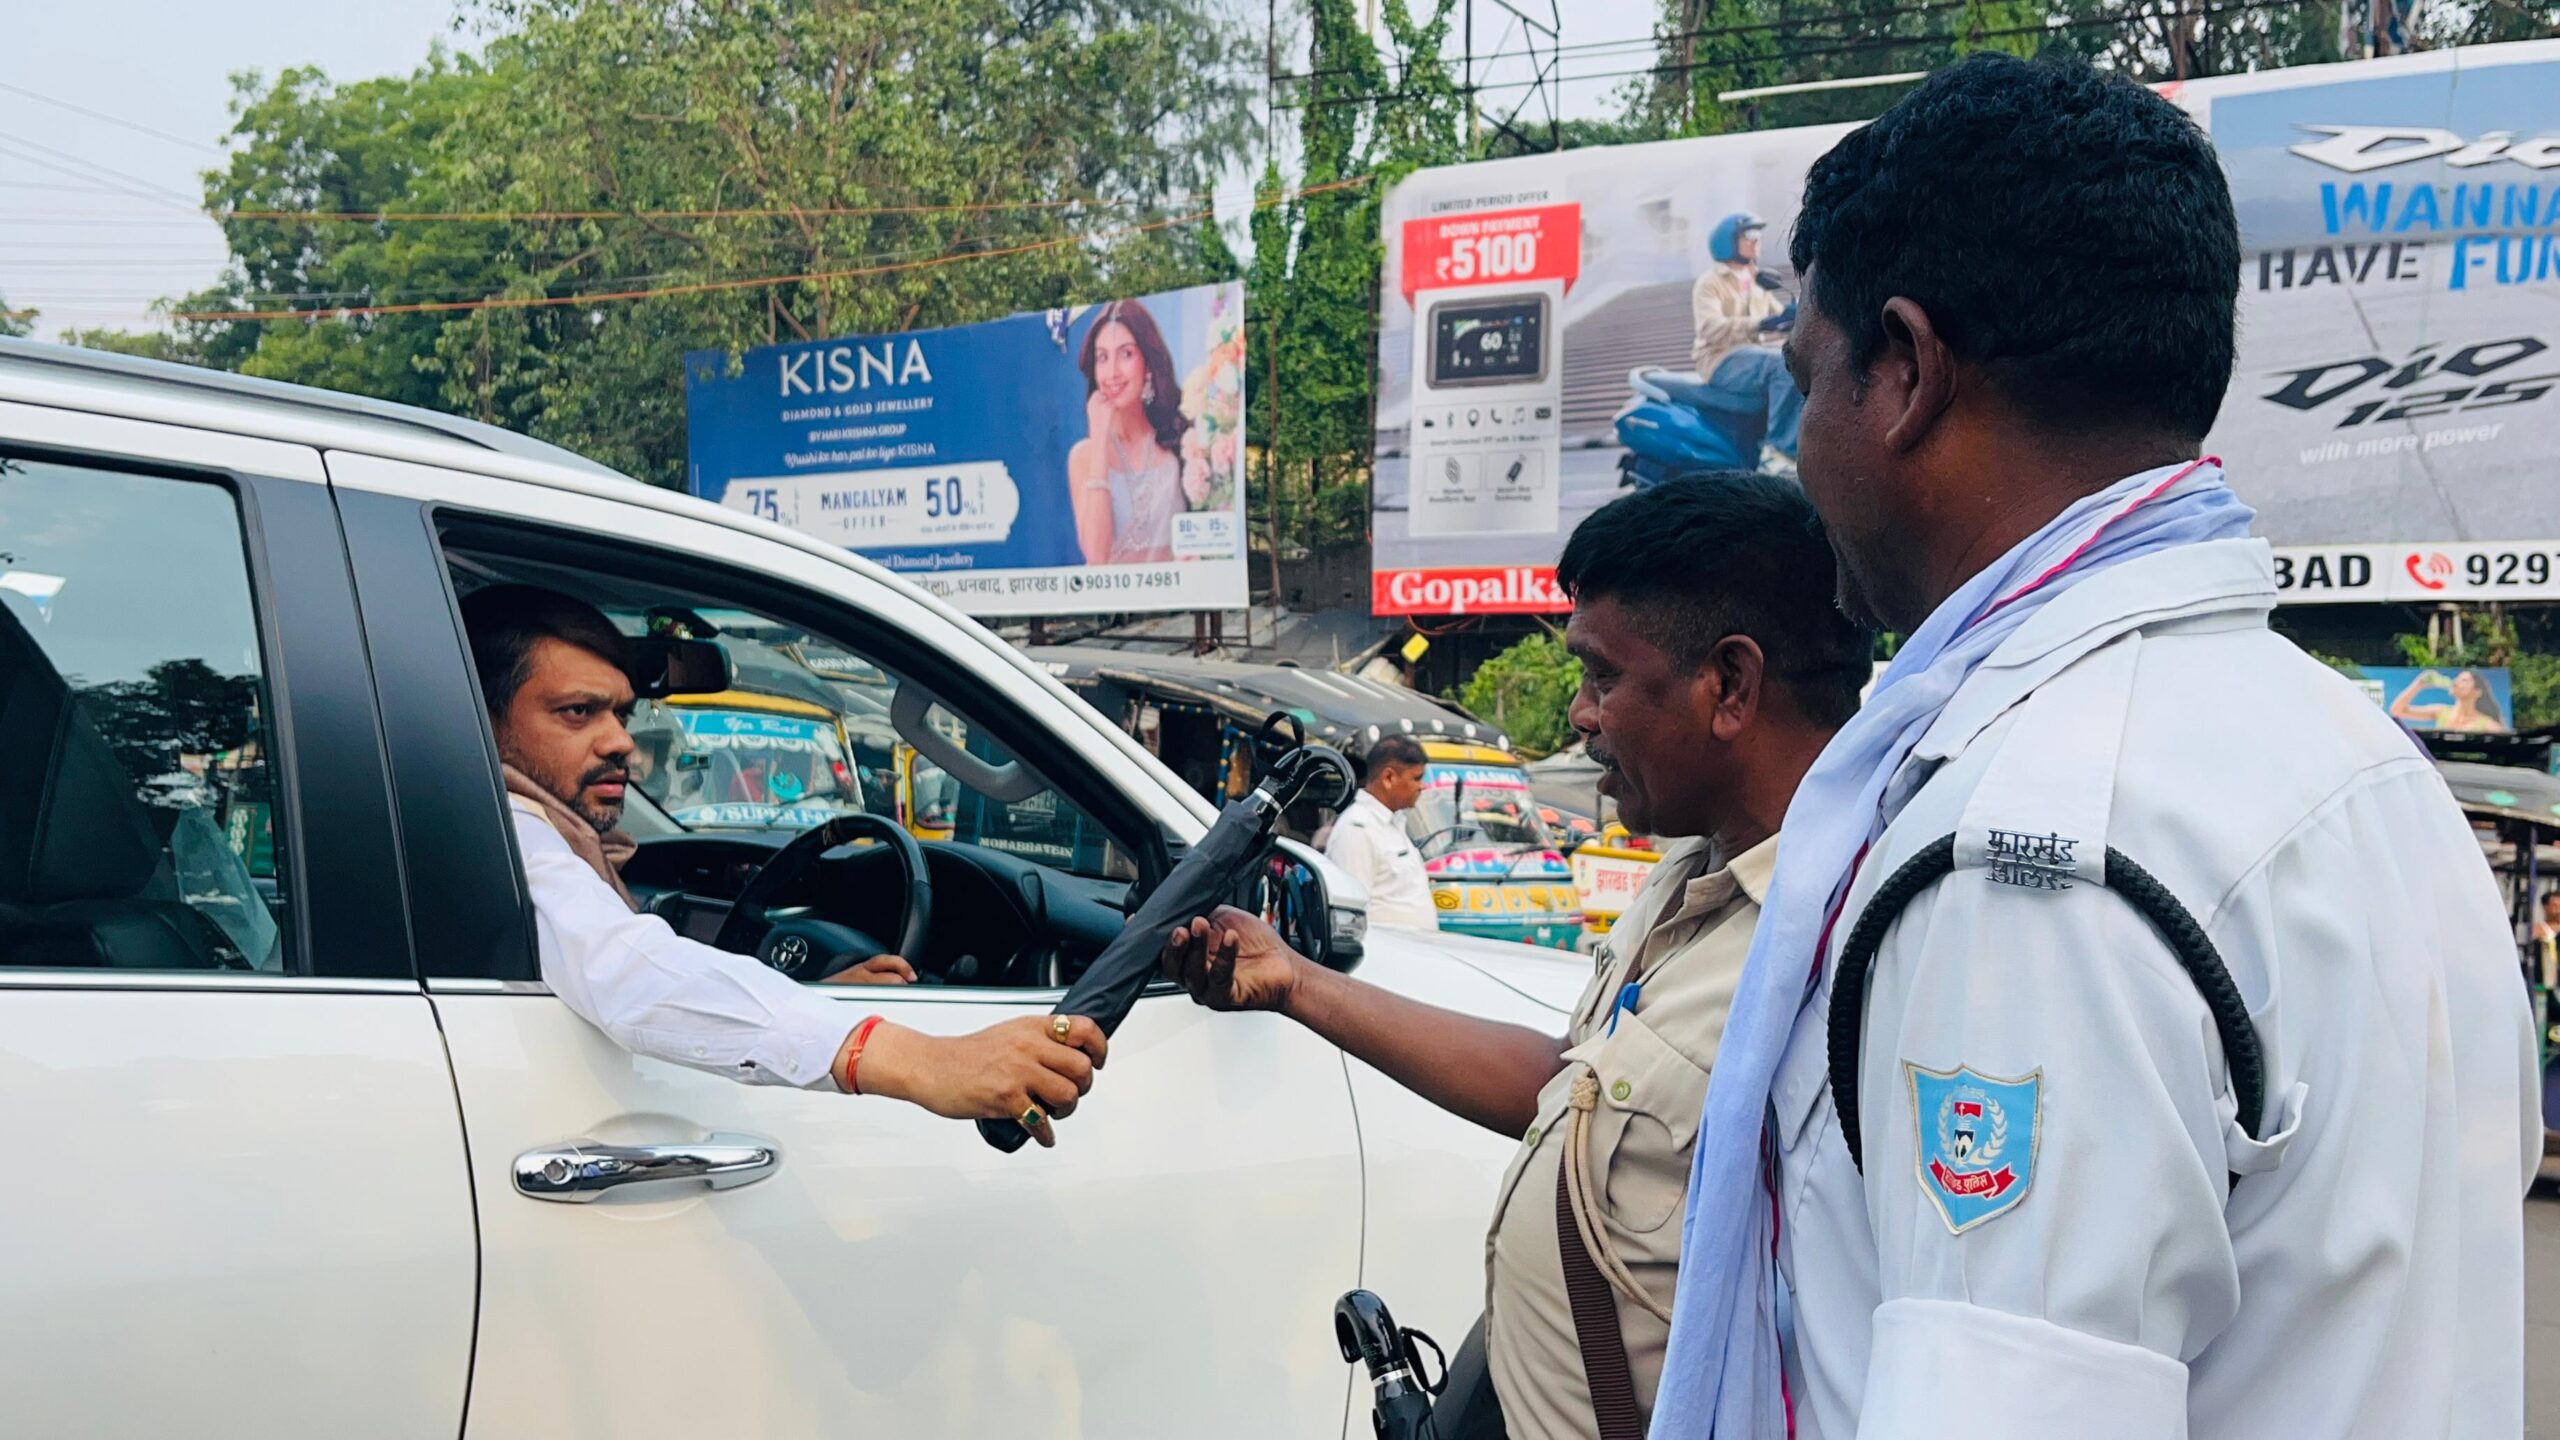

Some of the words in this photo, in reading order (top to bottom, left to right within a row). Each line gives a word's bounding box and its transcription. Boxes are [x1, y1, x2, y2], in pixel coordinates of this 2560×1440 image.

[1476, 194, 1513, 207] PERIOD
[1517, 190, 1549, 203] OFFER
[1439, 221, 1479, 239] DOWN
[1481, 215, 1541, 234] PAYMENT
[2258, 241, 2426, 290] HAVE
[2449, 234, 2560, 290] FUN
[1480, 331, 1503, 351] 60
[780, 338, 932, 397] KISNA
[782, 406, 832, 422] DIAMOND
[833, 406, 842, 418] &
[845, 401, 873, 416] GOLD
[876, 396, 934, 414] JEWELLERY
[2334, 374, 2560, 430] 125
[809, 431, 821, 443] BY
[821, 428, 842, 441] HARI
[842, 425, 877, 439] KRISHNA
[878, 423, 908, 436] GROUP
[897, 442, 936, 457] KISNA
[2300, 440, 2350, 464] with
[2356, 434, 2418, 456] more
[2423, 424, 2503, 452] power
[821, 488, 908, 511] MANGALYAM
[843, 514, 886, 530] OFFER
[894, 553, 933, 568] Diamond
[933, 552, 975, 570] Jewellery
[2466, 552, 2560, 587] 929
[1086, 573, 1131, 590] 90310
[1136, 571, 1181, 587] 74981
[725, 805, 802, 821] SUPER
[1963, 1173, 1988, 1194] पुलिस
